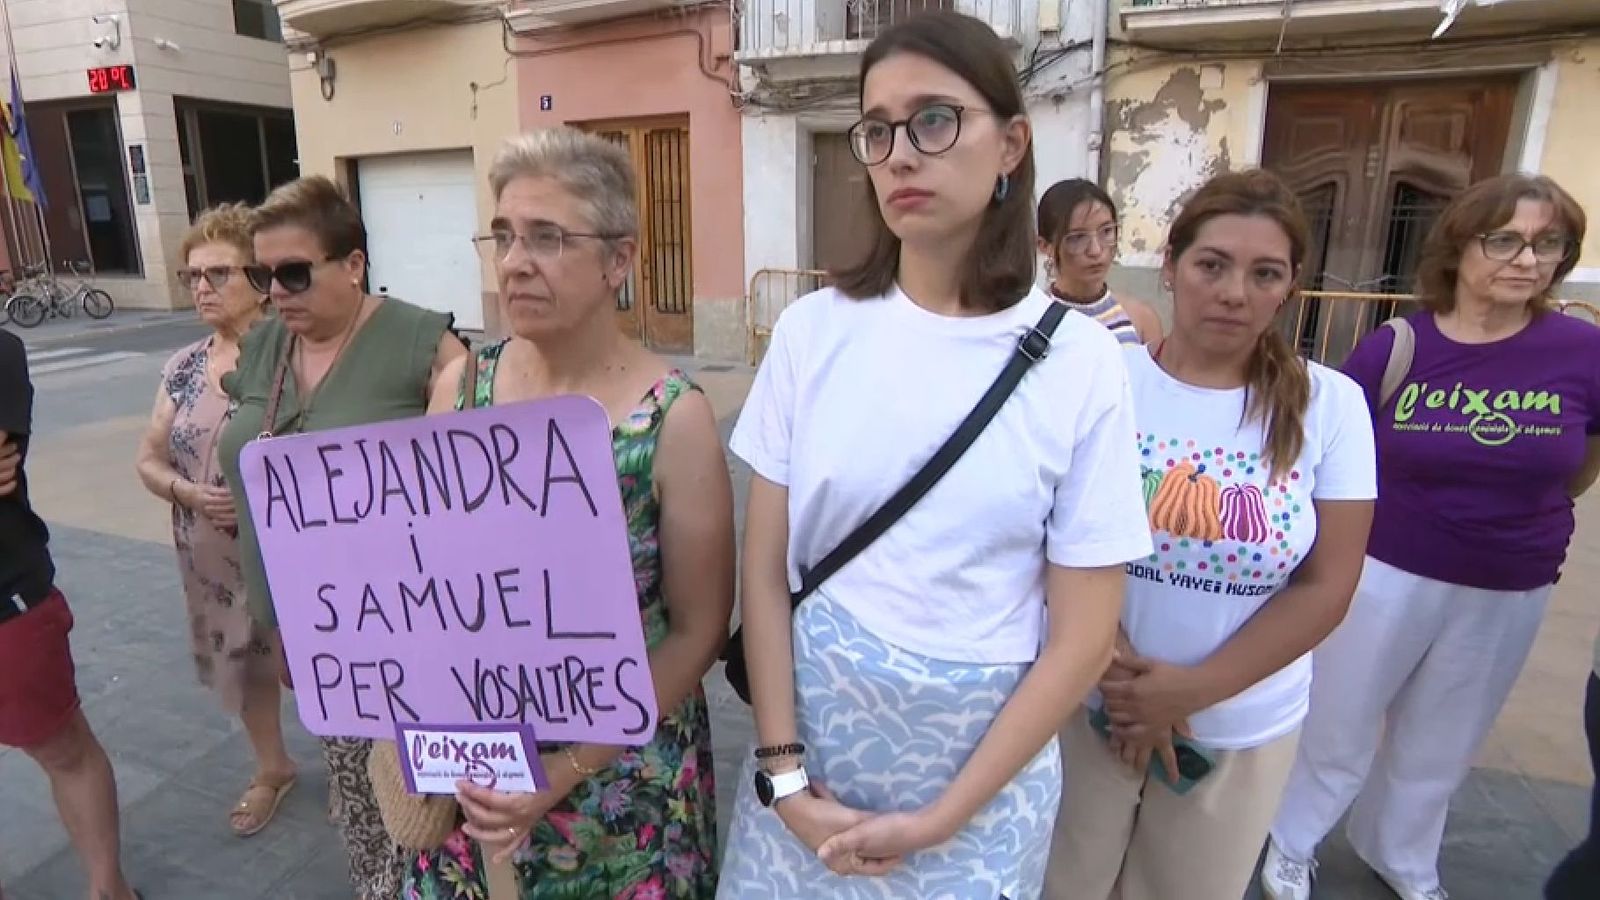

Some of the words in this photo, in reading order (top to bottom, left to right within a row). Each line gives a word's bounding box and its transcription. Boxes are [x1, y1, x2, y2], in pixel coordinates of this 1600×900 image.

[262, 417, 599, 532] ALEJANDRA
[407, 521, 424, 574] i
[313, 567, 617, 640] SAMUEL
[311, 653, 420, 723] PER
[450, 655, 651, 735] VOSALTRES
